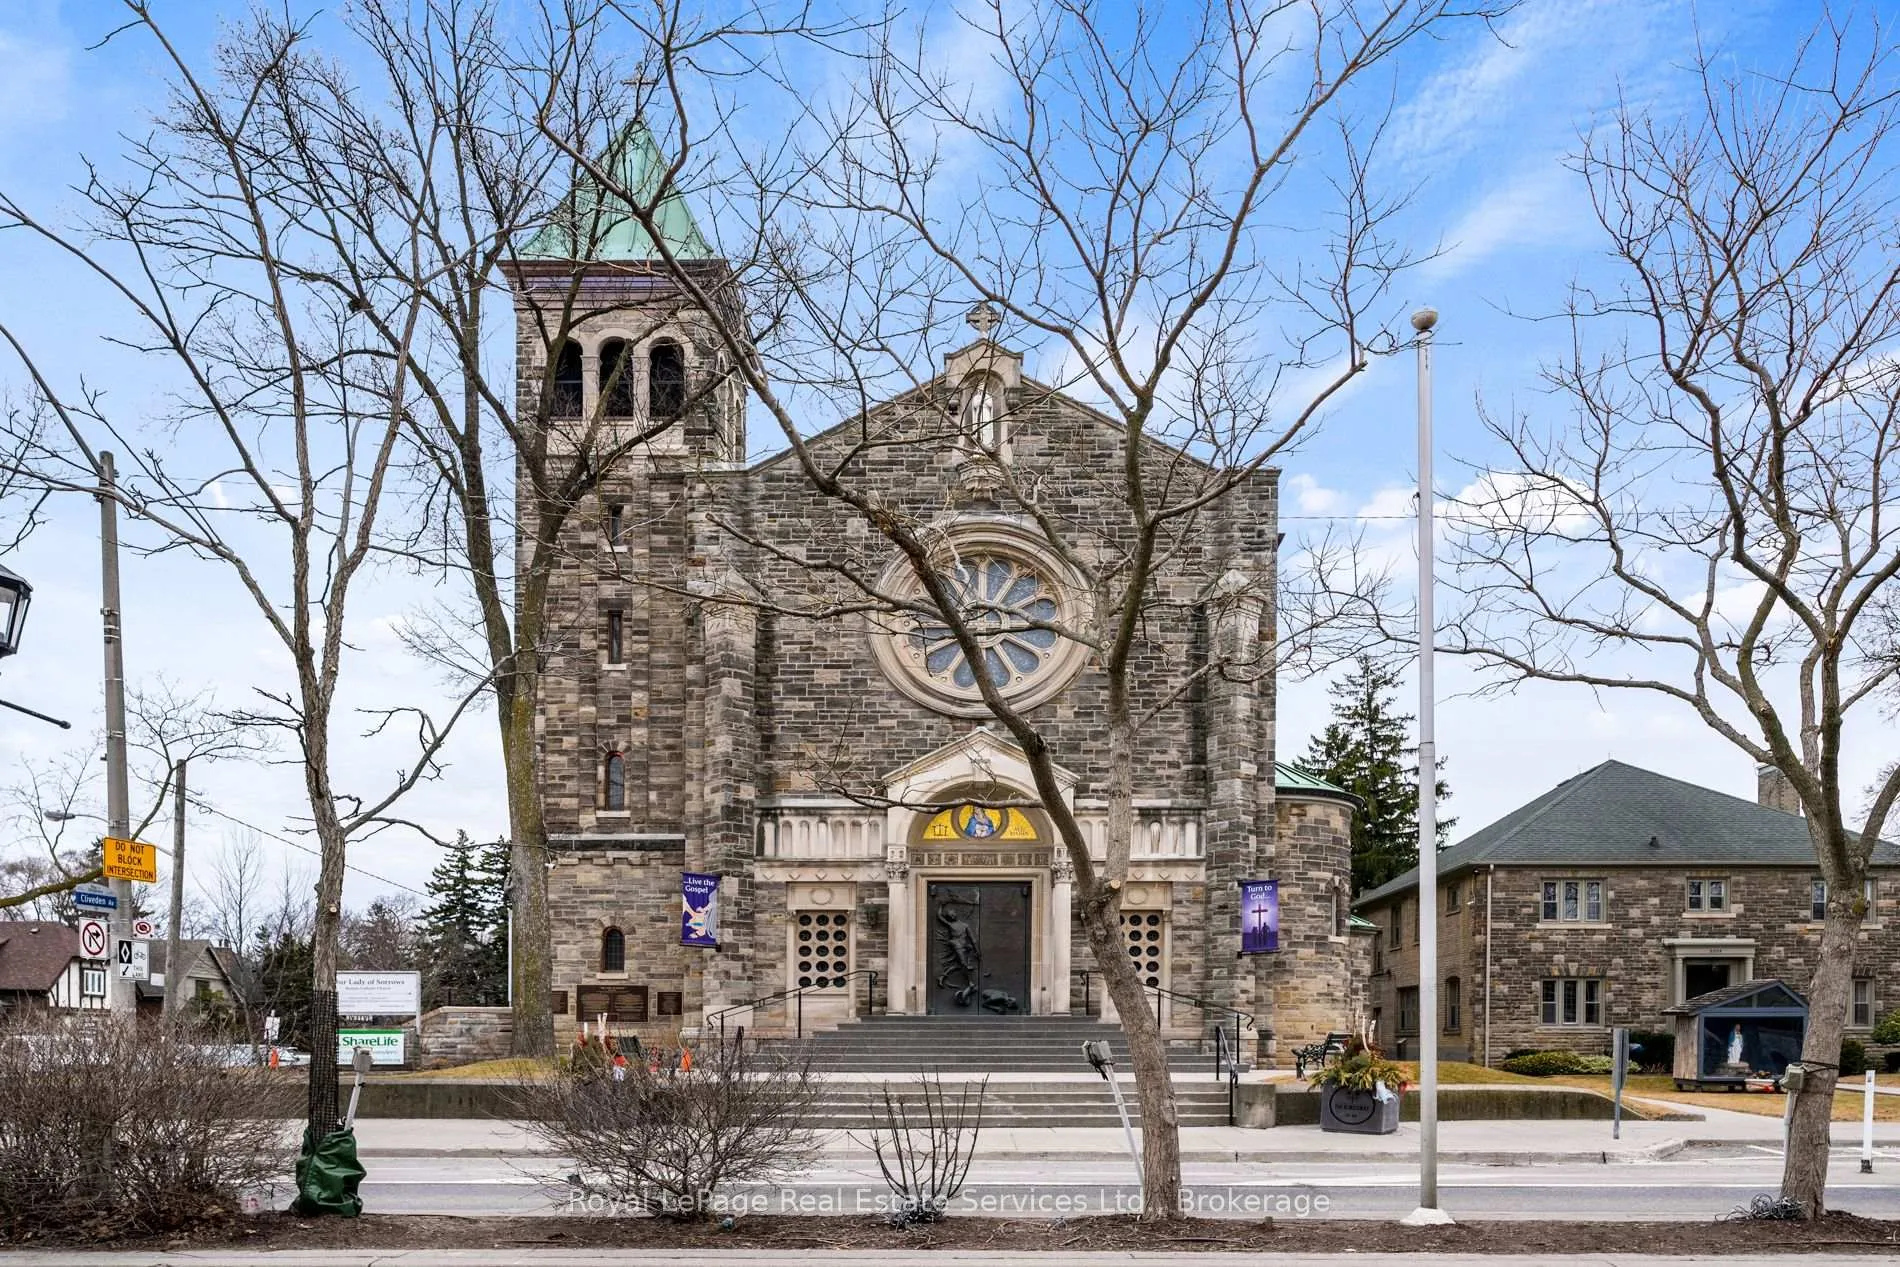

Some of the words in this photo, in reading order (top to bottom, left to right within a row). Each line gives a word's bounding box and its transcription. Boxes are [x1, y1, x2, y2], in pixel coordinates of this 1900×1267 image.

[115, 841, 126, 851] DO
[130, 845, 144, 854] NOT
[117, 854, 142, 865] BLOCK
[106, 864, 154, 879] INTERSECTION
[703, 878, 715, 887] the
[685, 885, 709, 894] Gospel
[1247, 885, 1263, 893] Turn
[80, 894, 106, 905] Cliveden
[348, 978, 365, 986] Lady
[342, 1036, 398, 1046] ShareLife
